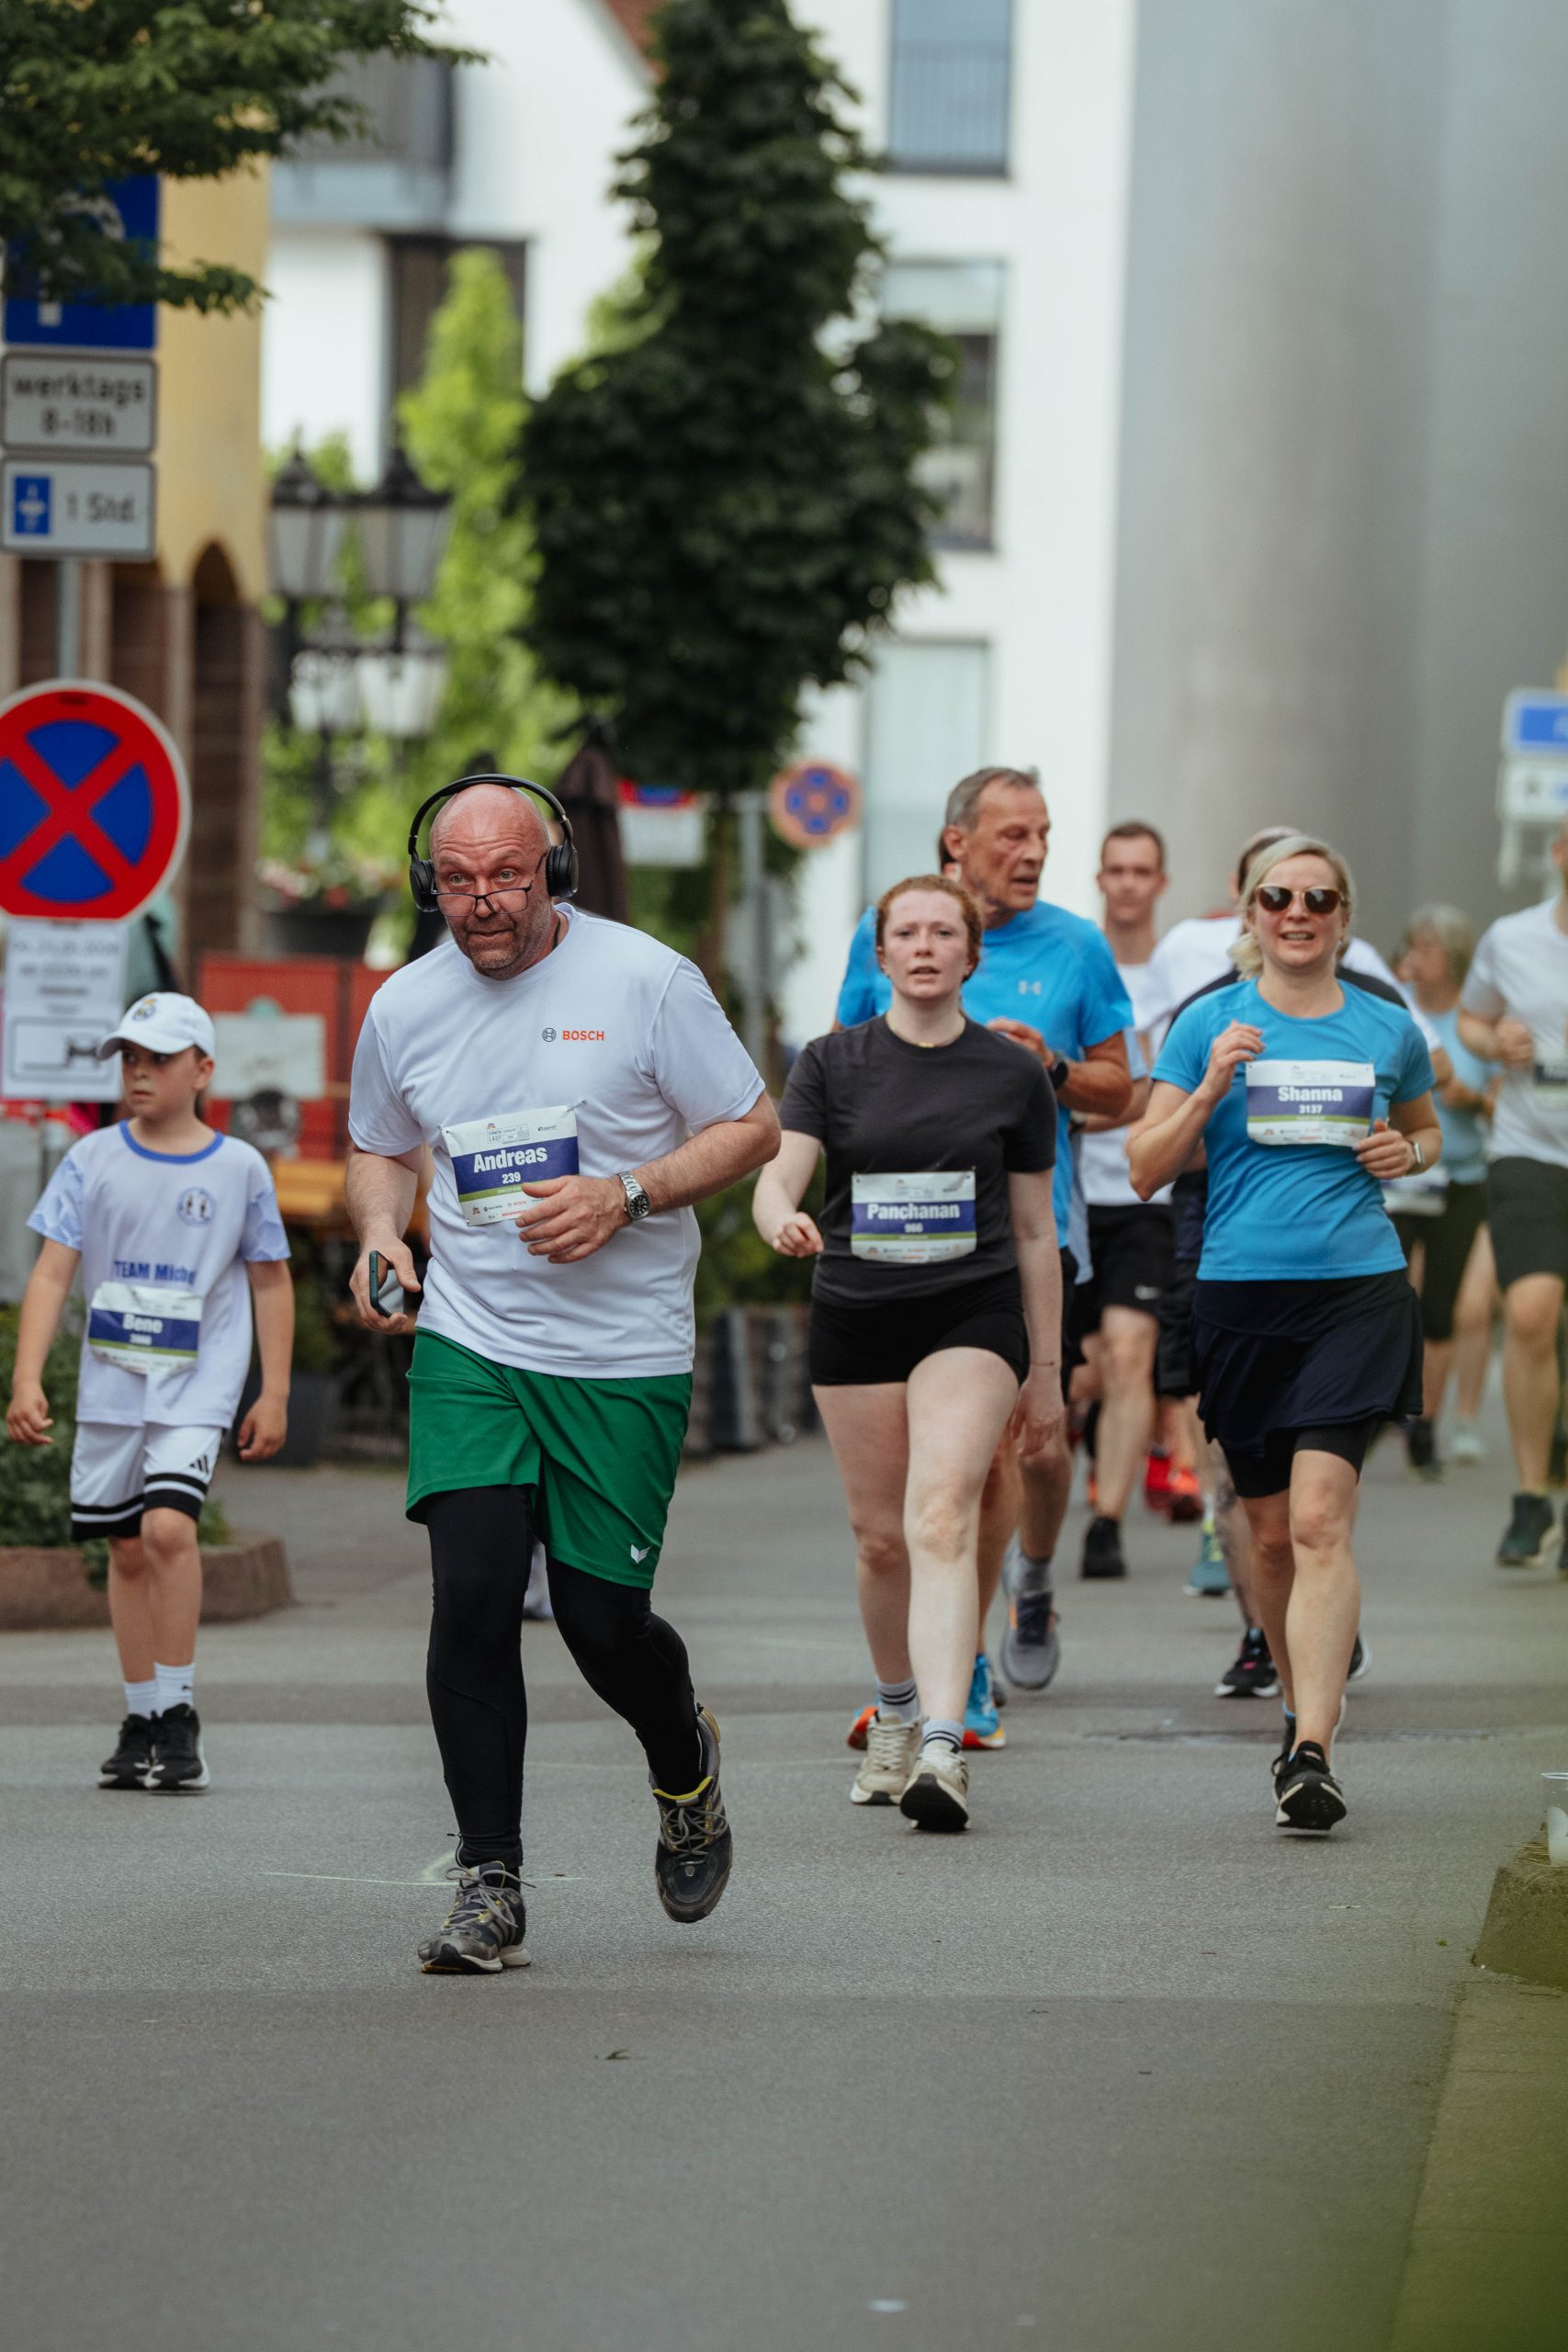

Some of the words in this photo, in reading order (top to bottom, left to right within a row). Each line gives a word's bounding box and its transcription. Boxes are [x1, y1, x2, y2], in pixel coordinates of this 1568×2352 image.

[14, 373, 144, 408] werktags
[562, 1030, 604, 1041] BOSCH
[1278, 1086, 1343, 1102] Shanna
[473, 1147, 548, 1173] Andreas
[502, 1171, 522, 1185] 239
[867, 1203, 961, 1220] Panchanan
[114, 1261, 150, 1279] TEAM
